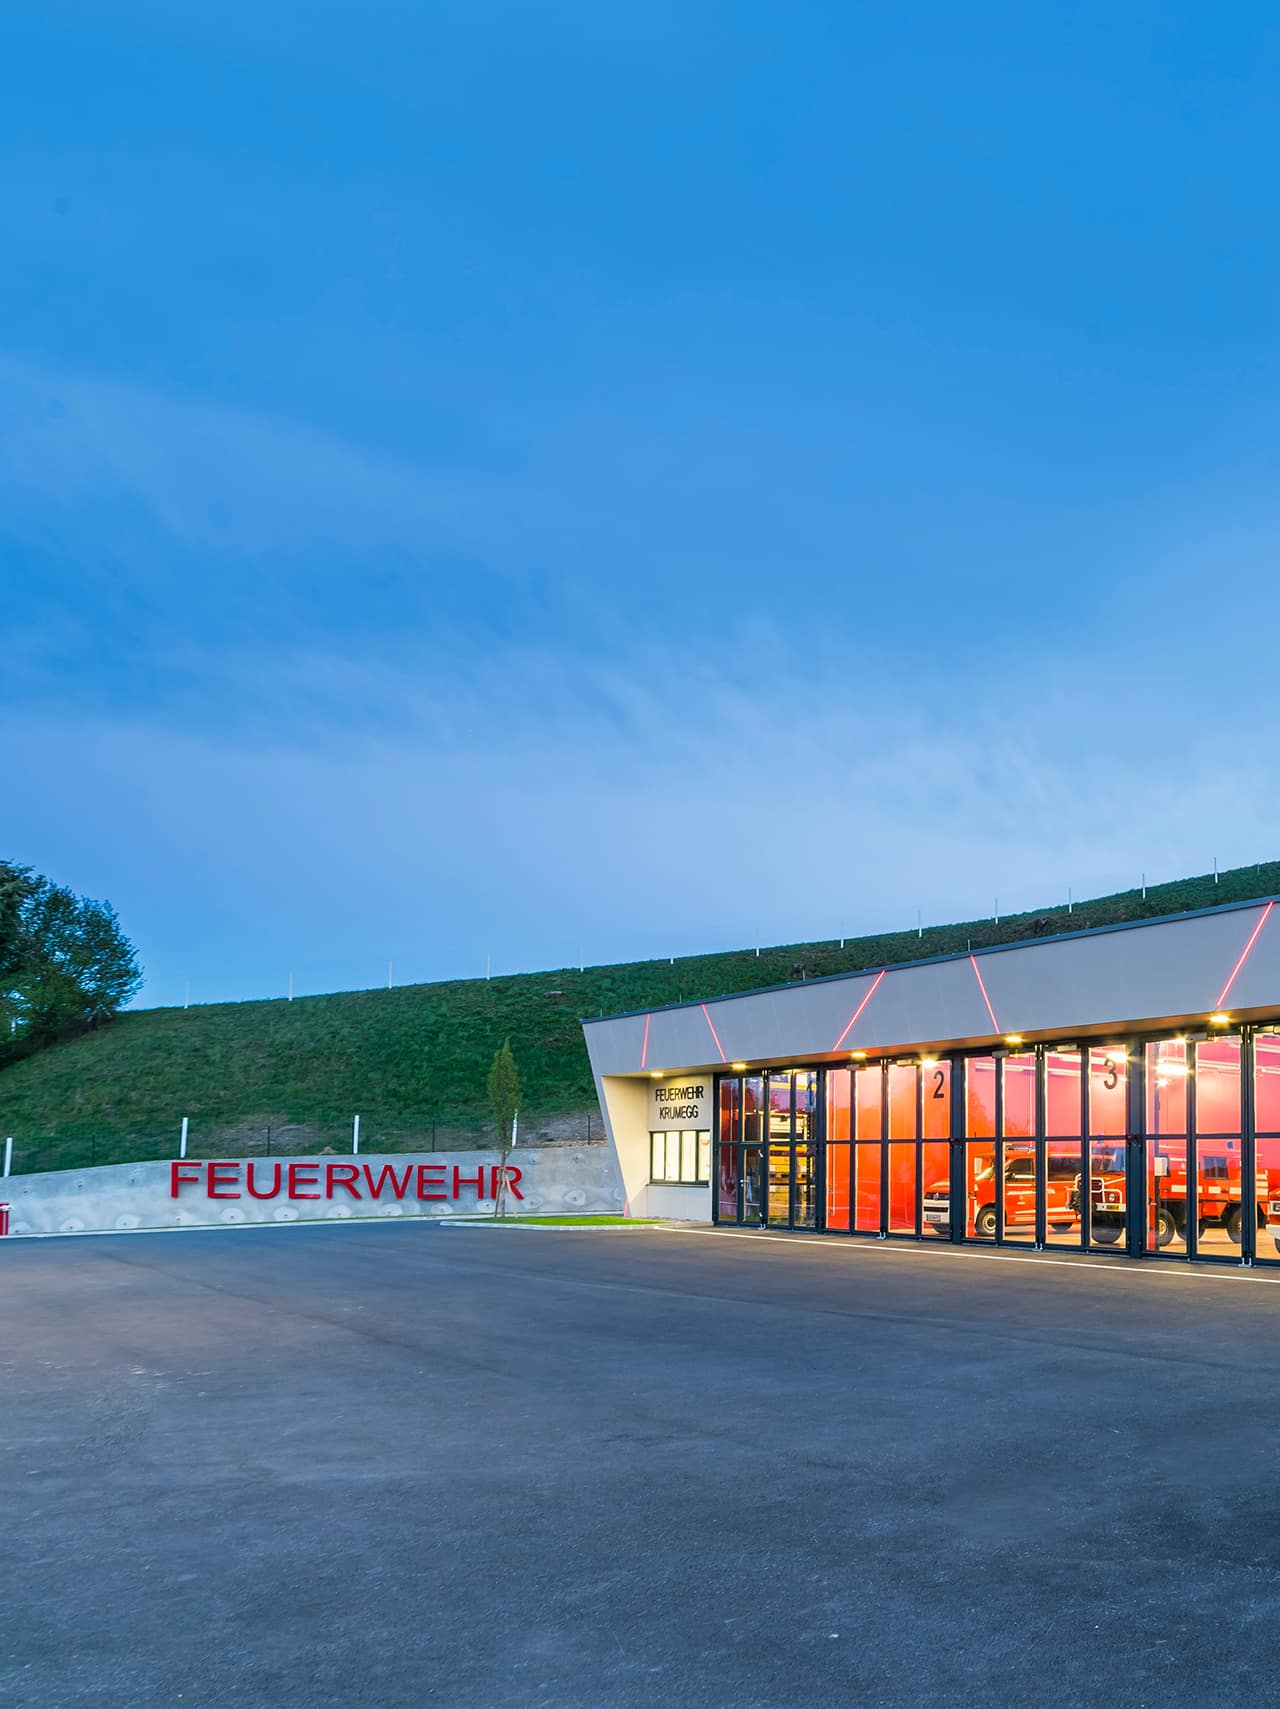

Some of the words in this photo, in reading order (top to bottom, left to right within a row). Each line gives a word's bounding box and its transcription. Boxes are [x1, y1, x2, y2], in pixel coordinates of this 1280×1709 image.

[933, 1071, 944, 1099] 2
[1103, 1057, 1118, 1090] 3
[655, 1085, 704, 1102] FEUERWEHR
[659, 1105, 698, 1119] KRUMEGG
[170, 1160, 524, 1200] FEUERWEHR
